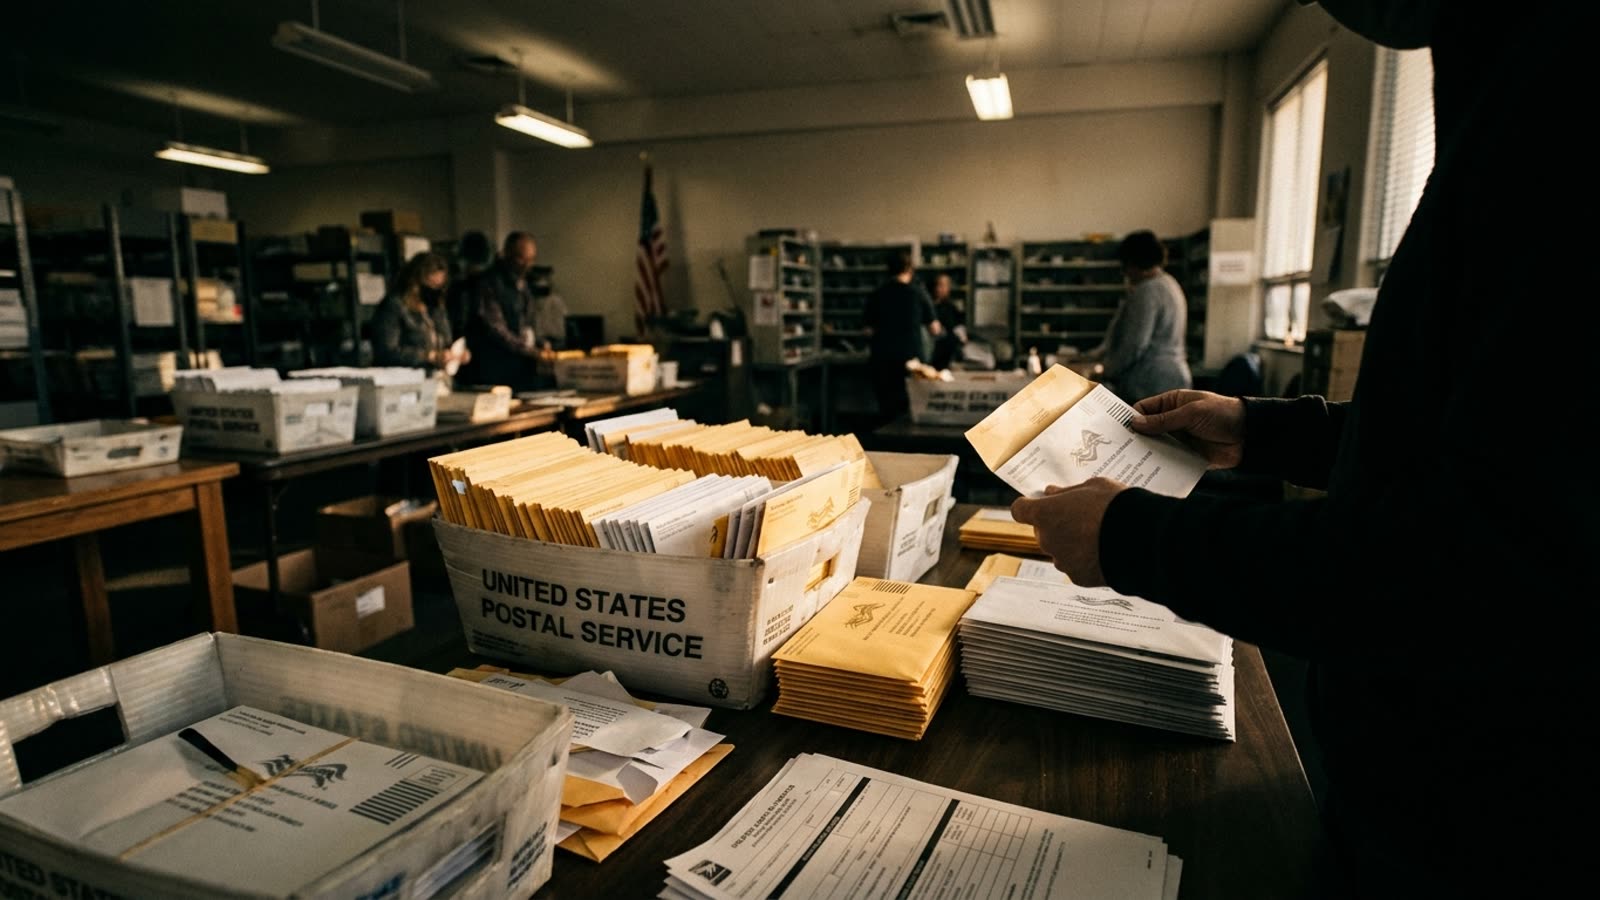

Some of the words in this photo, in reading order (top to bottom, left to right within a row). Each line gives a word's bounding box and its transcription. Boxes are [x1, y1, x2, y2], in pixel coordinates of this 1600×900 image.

[482, 568, 568, 607] UNITED
[575, 587, 686, 623] STATES
[481, 598, 574, 639] POSTAL
[581, 621, 704, 659] SERVICE
